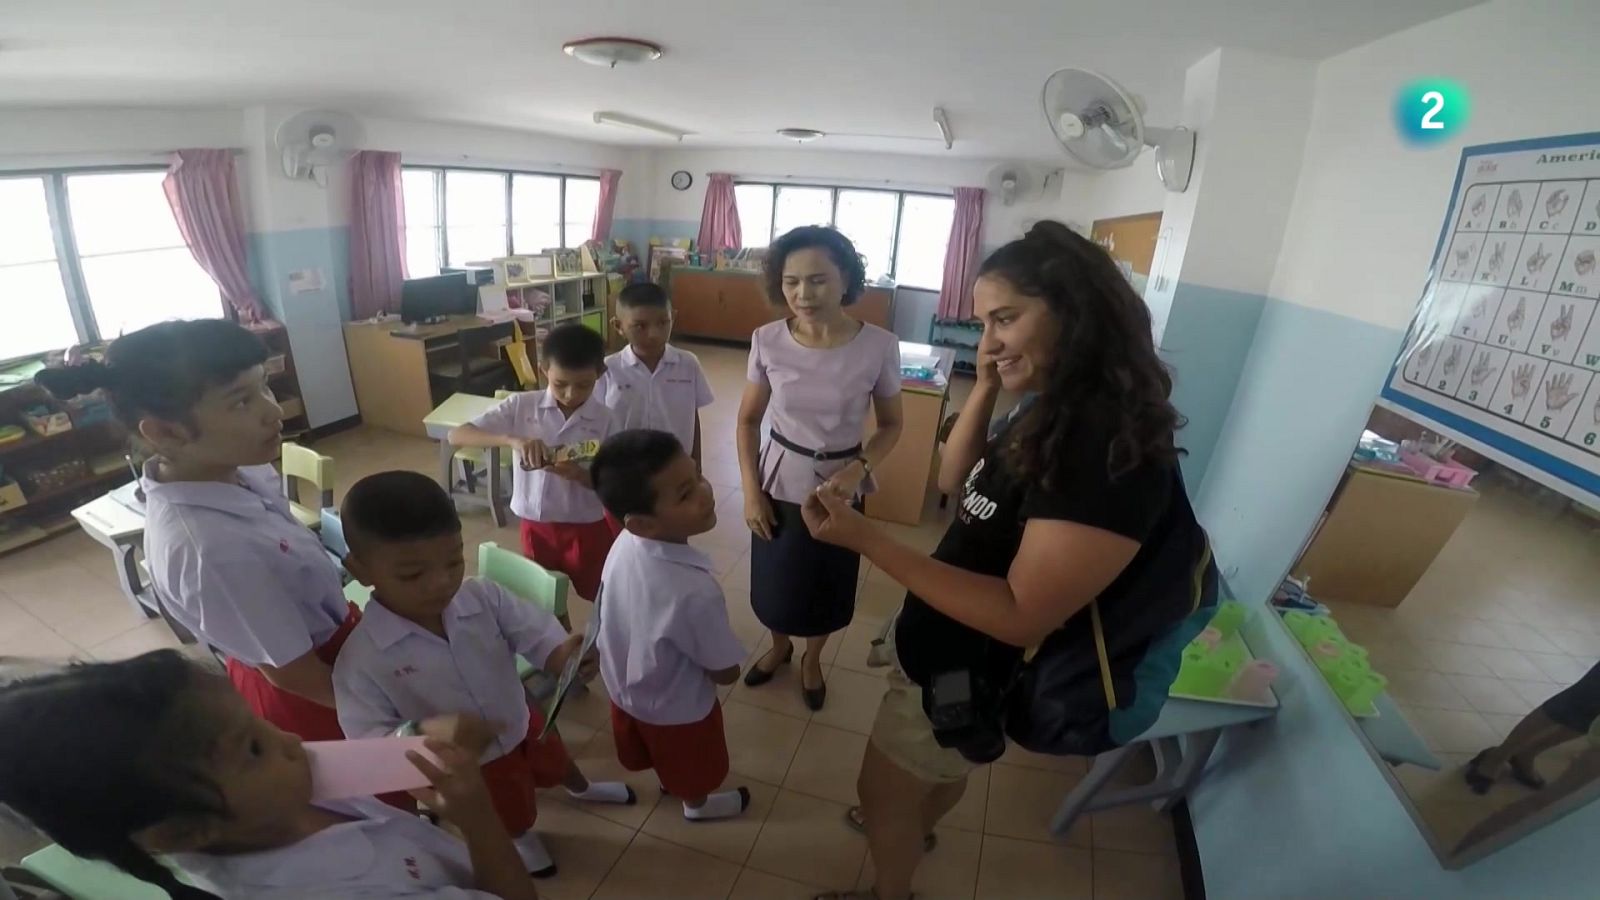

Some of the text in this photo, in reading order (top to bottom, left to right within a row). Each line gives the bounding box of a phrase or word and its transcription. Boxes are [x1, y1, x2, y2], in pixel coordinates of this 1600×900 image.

[1499, 221, 1507, 229] B
[1539, 221, 1549, 230] C
[1585, 221, 1597, 231] D
[1520, 276, 1529, 285] L
[1559, 281, 1574, 292] M
[1498, 335, 1509, 345] U
[1541, 344, 1552, 355] V
[1585, 354, 1600, 366] W
[1438, 380, 1447, 390] 2
[1468, 391, 1478, 401] 3
[1504, 403, 1514, 415] 4
[1540, 416, 1552, 429] 5
[1584, 432, 1597, 446] 6
